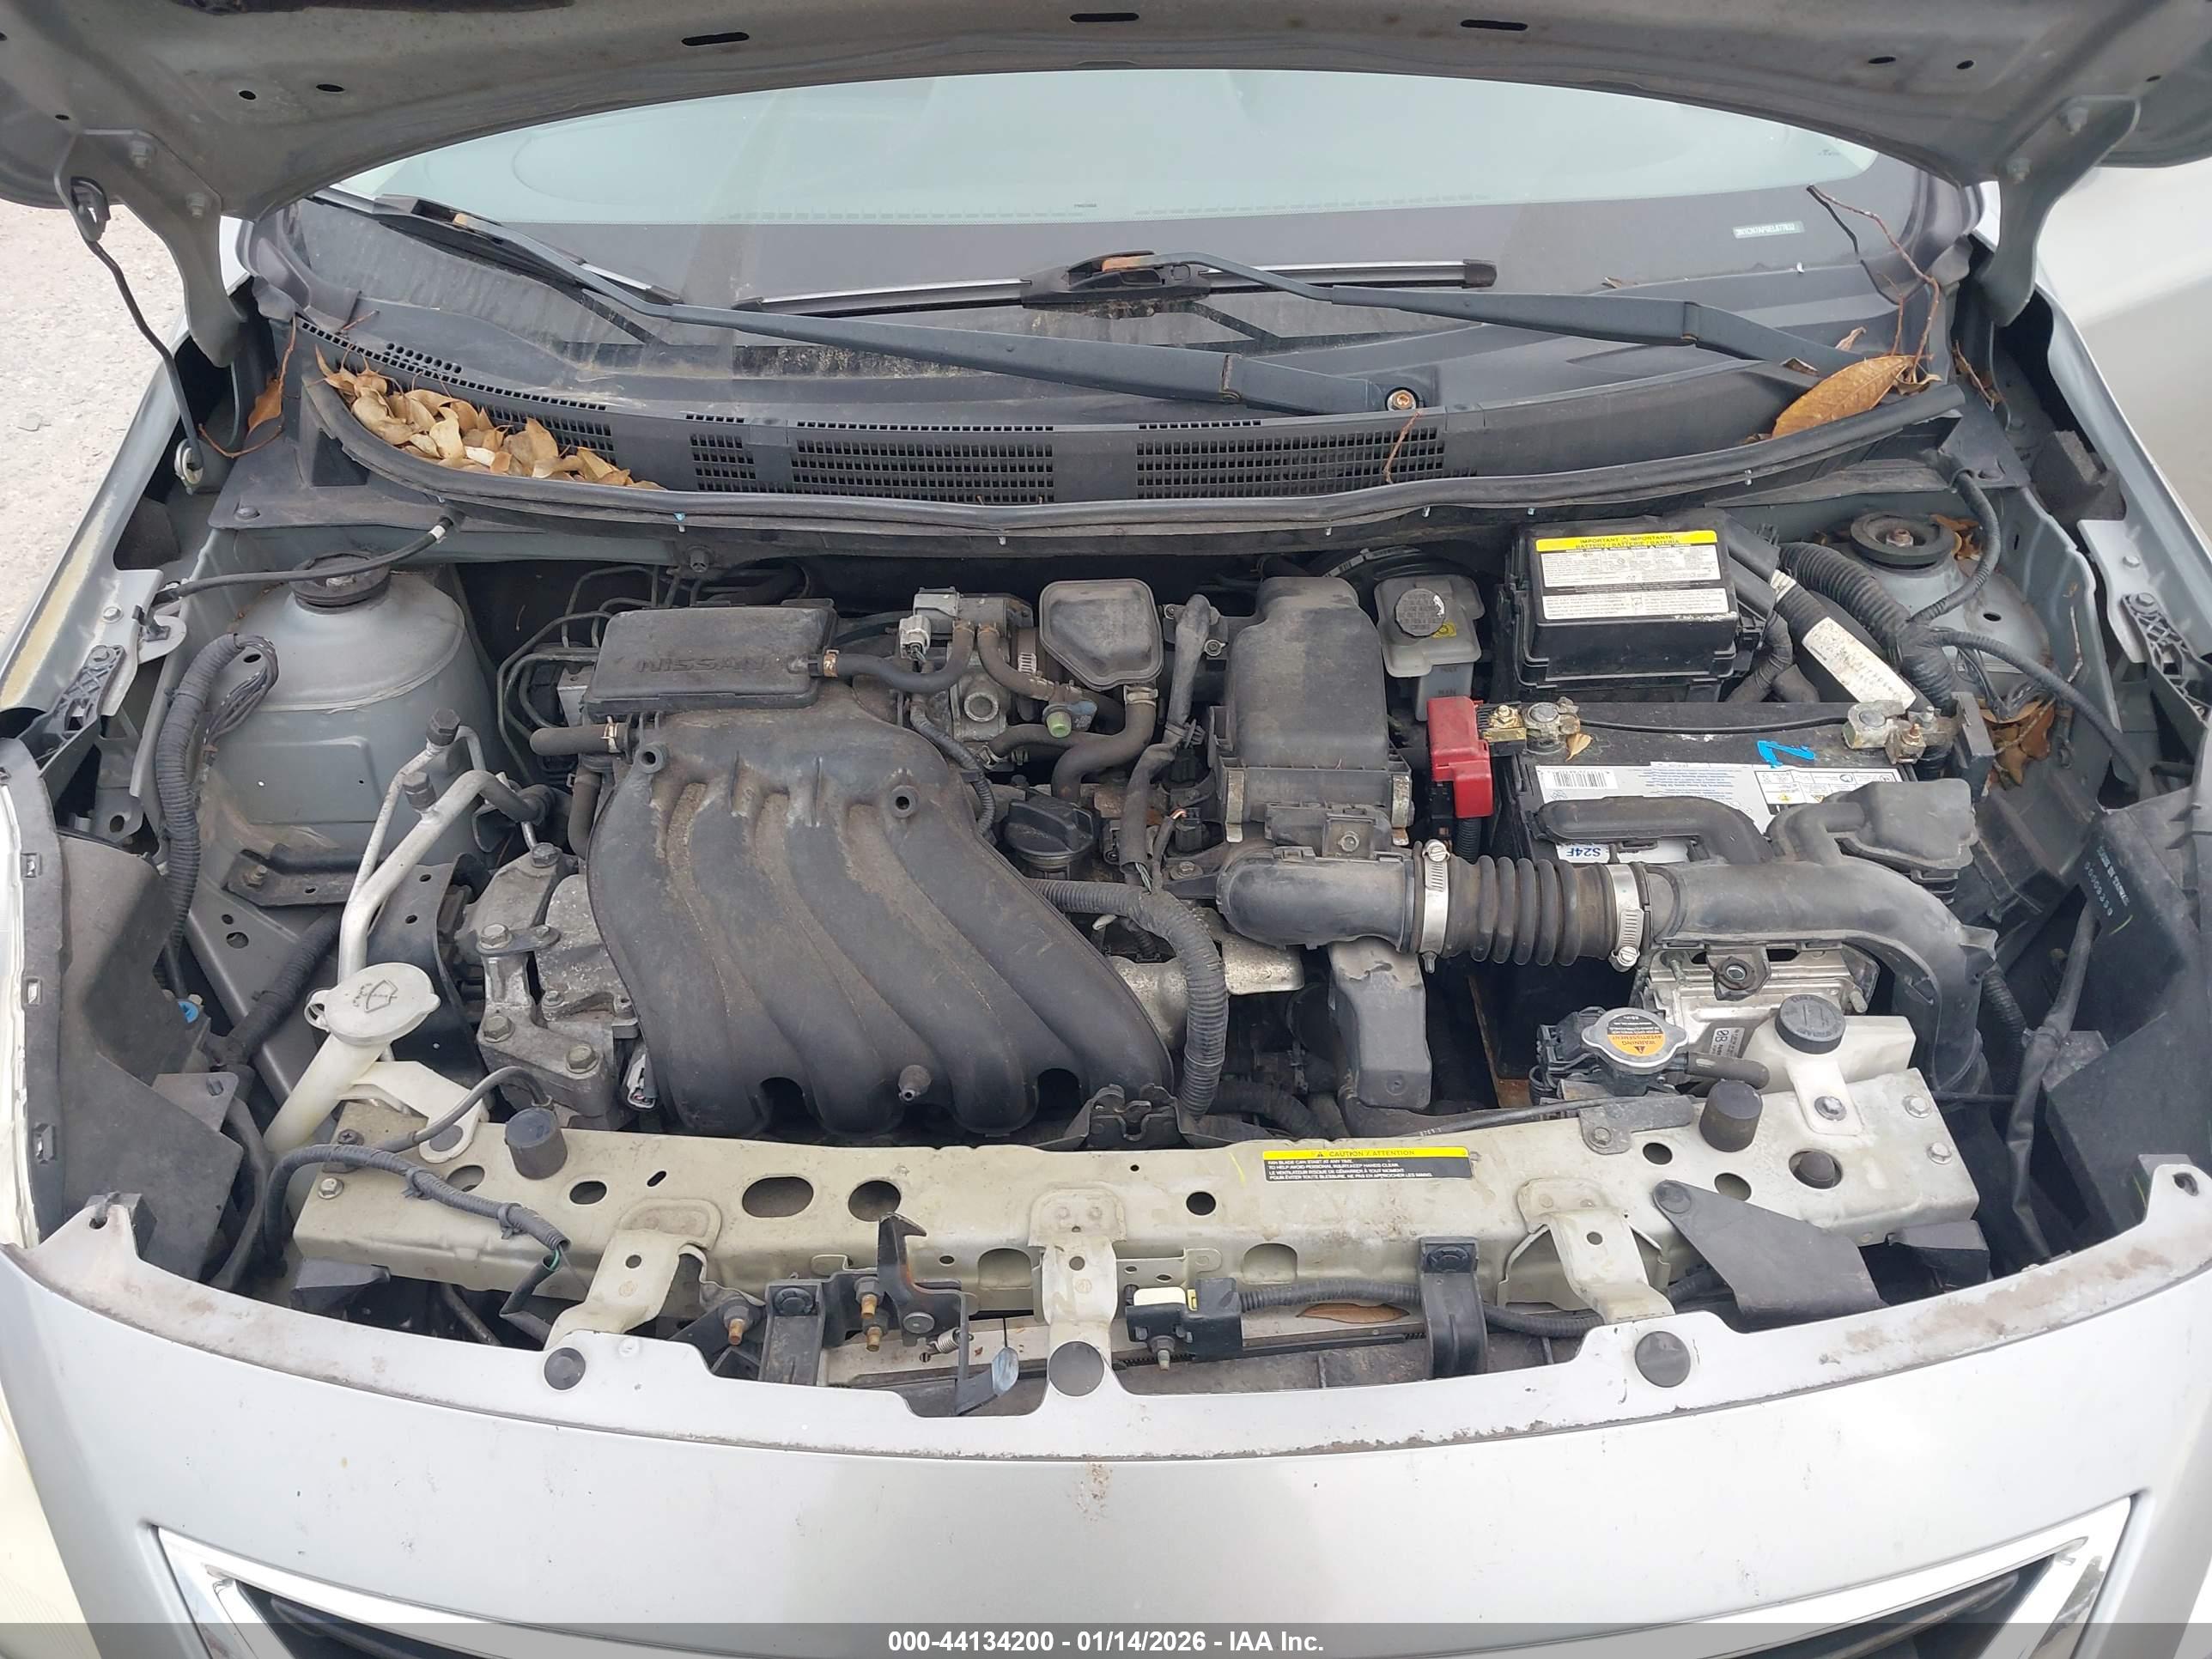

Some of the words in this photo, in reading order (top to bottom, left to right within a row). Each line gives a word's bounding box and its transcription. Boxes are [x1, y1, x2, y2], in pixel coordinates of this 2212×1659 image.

[636, 658, 765, 673] NISSAN
[1565, 848, 1601, 858] S24F
[1373, 1148, 1415, 1157] ATTENTION
